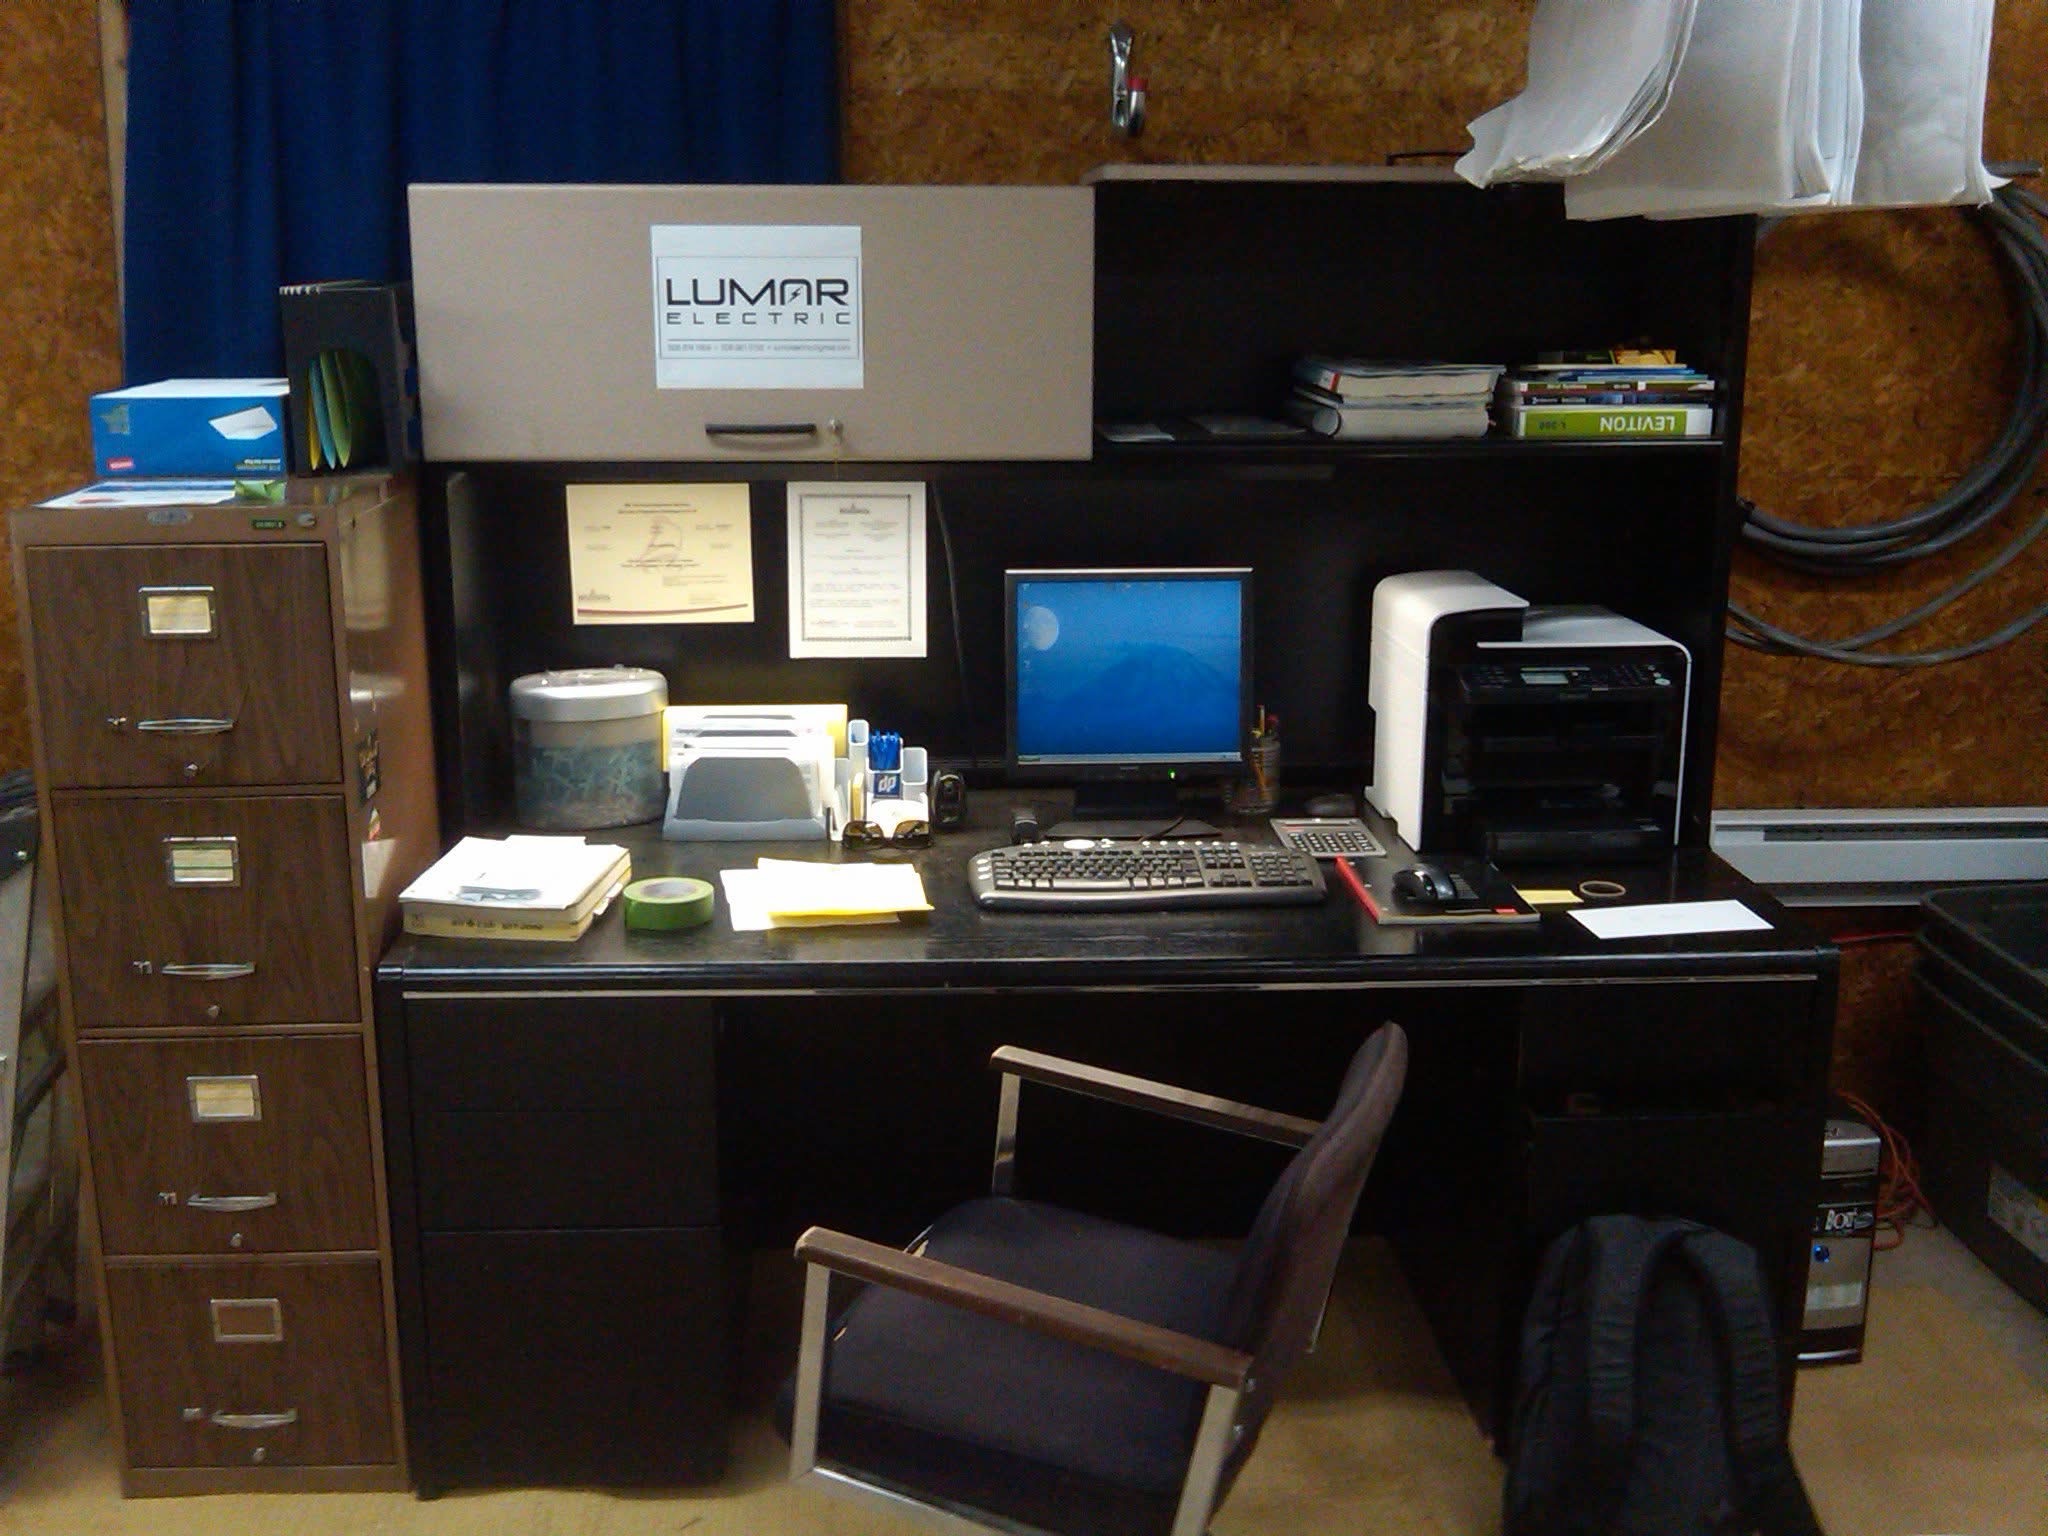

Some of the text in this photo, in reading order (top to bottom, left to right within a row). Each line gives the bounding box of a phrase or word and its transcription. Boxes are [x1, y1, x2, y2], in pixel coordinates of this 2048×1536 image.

[666, 278, 849, 306] LUMAR
[666, 312, 852, 325] ELECTRIC
[1599, 415, 1676, 433] LEVITON
